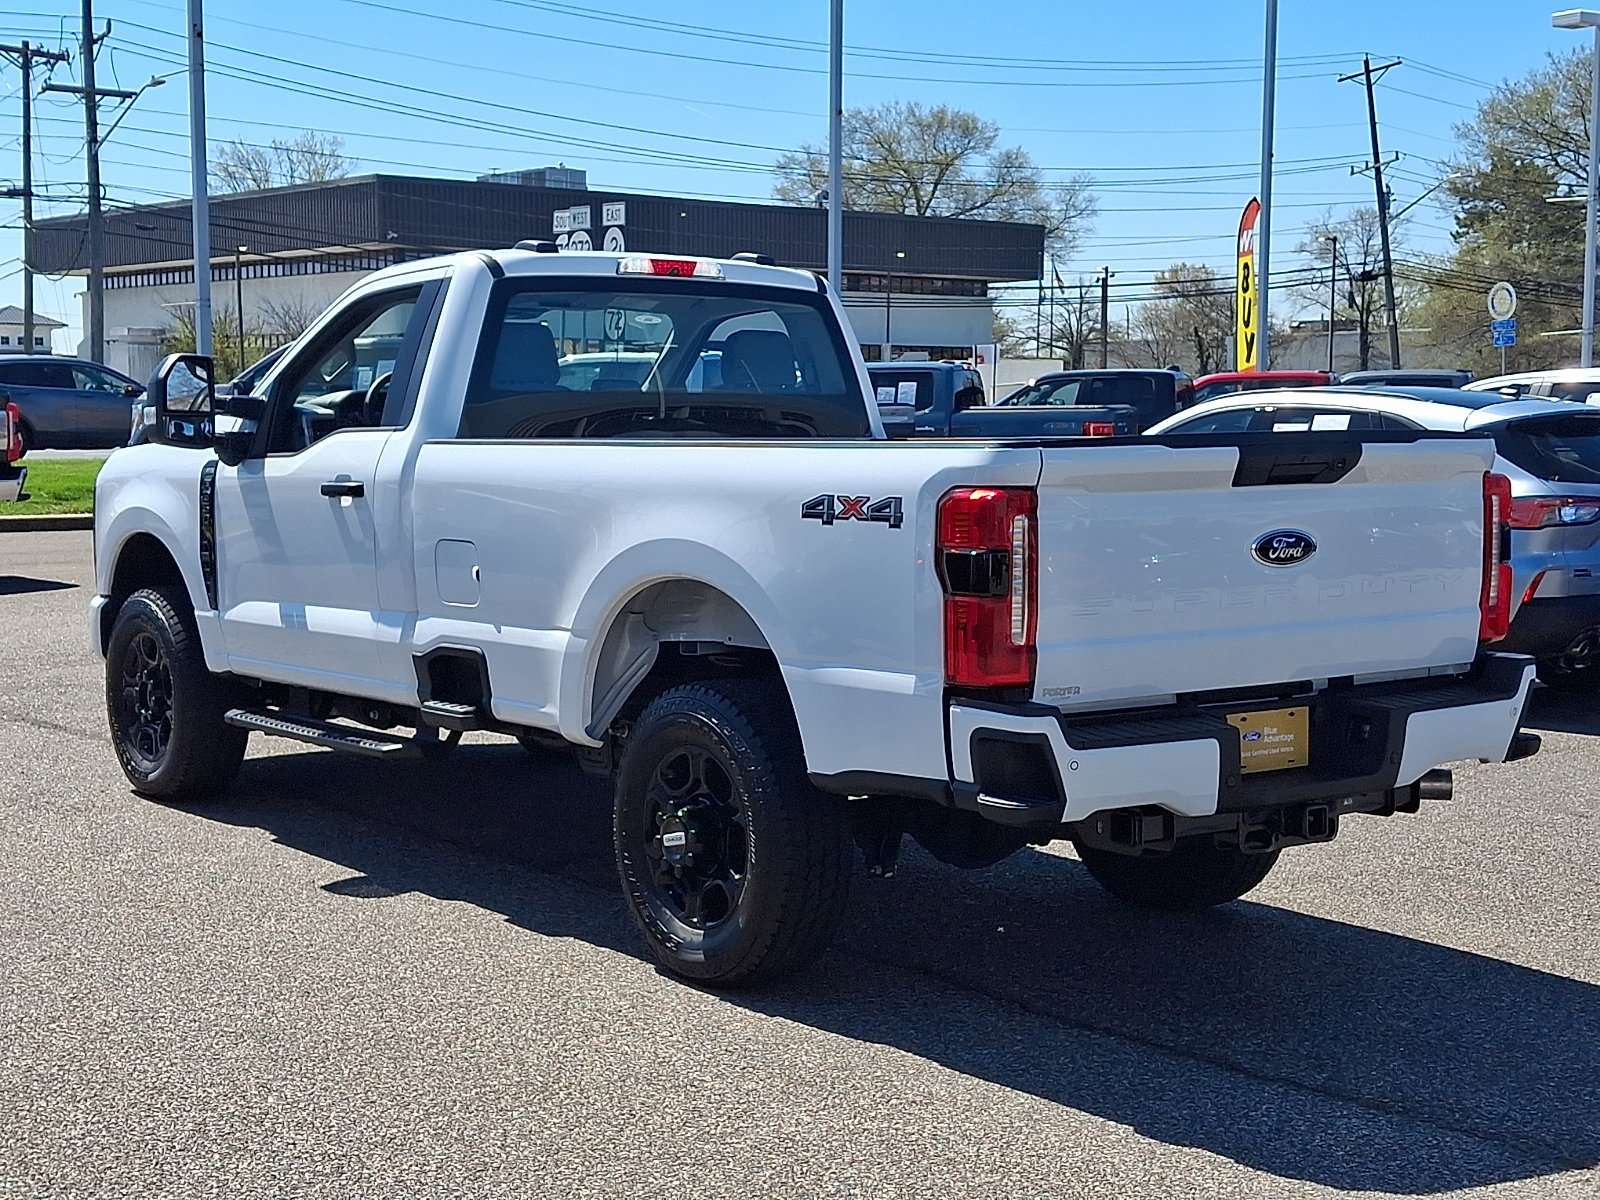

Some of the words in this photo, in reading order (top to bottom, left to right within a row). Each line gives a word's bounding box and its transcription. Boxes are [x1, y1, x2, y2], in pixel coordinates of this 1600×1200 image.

[555, 215, 571, 229] SOUT
[572, 211, 588, 225] WEST
[606, 208, 621, 222] EAST
[1241, 261, 1256, 364] BUY
[607, 311, 623, 331] 72
[1268, 536, 1306, 560] Ford
[1072, 582, 1299, 617] SUPER
[1317, 571, 1463, 602] DUTY
[1042, 685, 1081, 698] PORTER
[1264, 726, 1278, 735] Blue
[1264, 734, 1294, 743] Advantage
